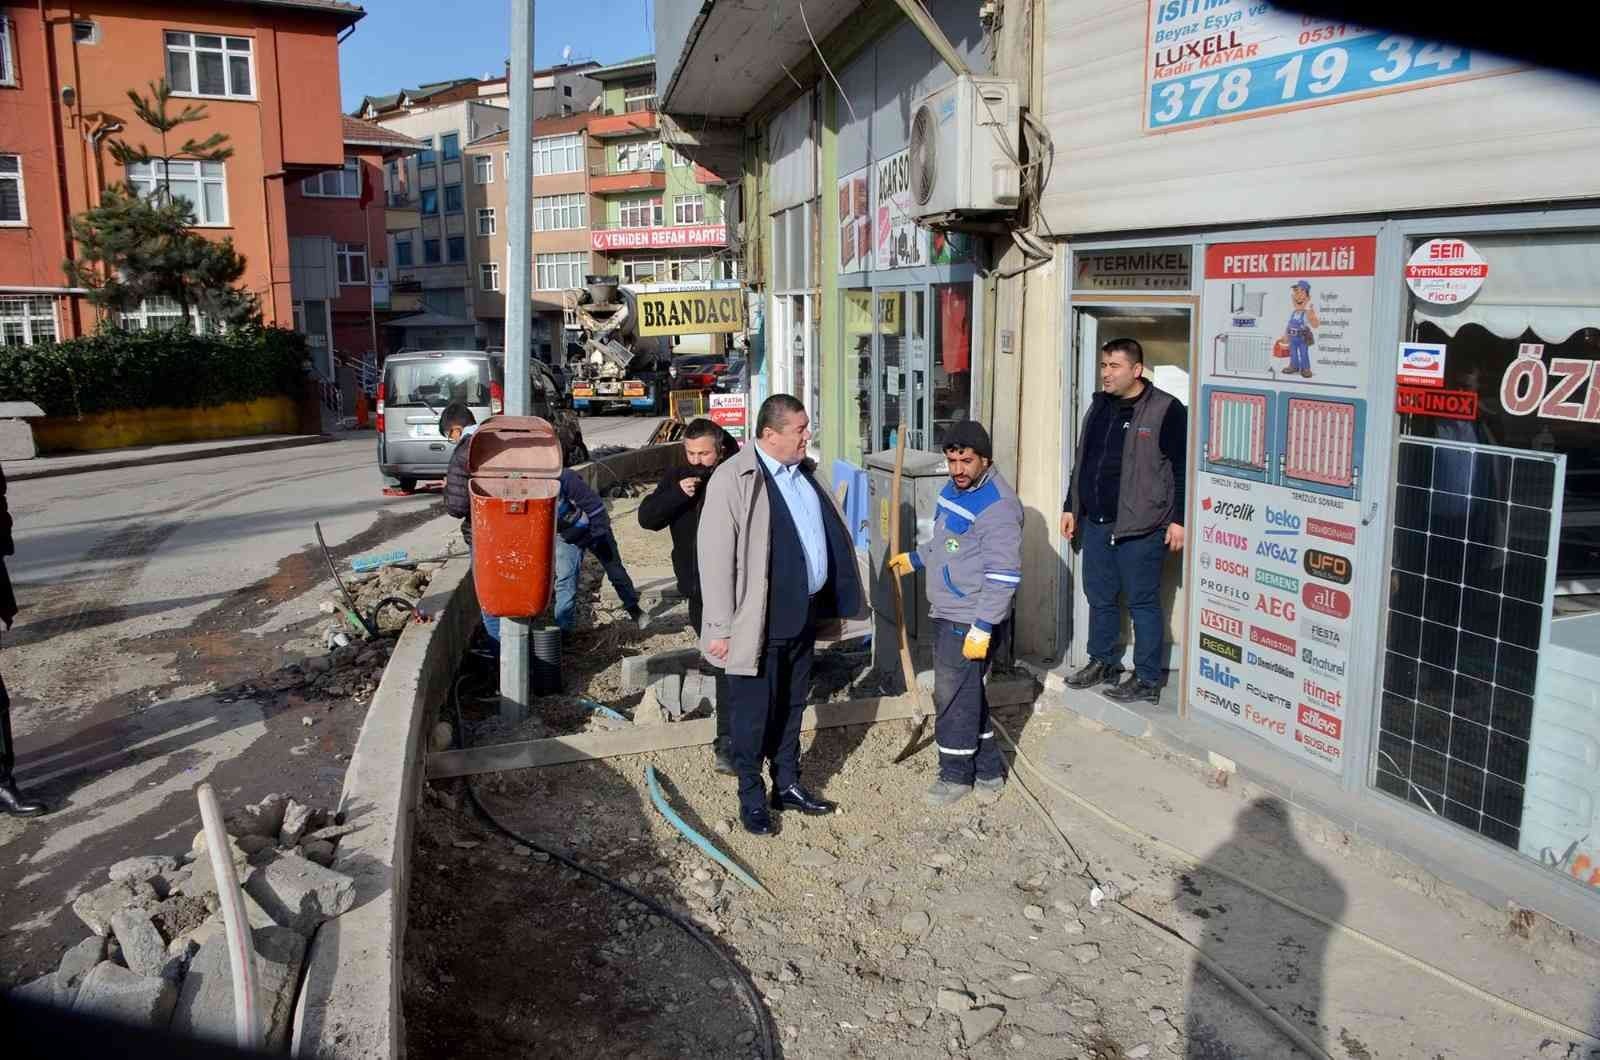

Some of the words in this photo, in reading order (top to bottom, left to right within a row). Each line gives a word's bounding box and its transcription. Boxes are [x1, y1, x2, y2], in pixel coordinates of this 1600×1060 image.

[1155, 23, 1199, 43] Beyaz
[1203, 10, 1242, 29] Eşya
[1248, 4, 1266, 17] ve
[1155, 31, 1243, 67] LUXELL
[1153, 60, 1193, 79] Kadir
[1200, 44, 1258, 69] KAYAR
[1154, 68, 1253, 122] 378
[1275, 47, 1349, 100] 19
[1369, 33, 1461, 82] 34
[606, 230, 649, 246] YENİDEN
[651, 229, 686, 244] REFAH
[1223, 254, 1269, 273] PETEK
[1272, 246, 1357, 272] TEMİZLİĞİ
[1430, 243, 1465, 258] SEM
[643, 297, 737, 327] BRANDACI
[1214, 500, 1256, 521] arçelik
[1265, 506, 1300, 530] beko
[1215, 528, 1248, 551] ALTUS
[1256, 541, 1298, 565] AYGAZ
[1310, 553, 1346, 575] UFO
[1215, 558, 1249, 578] BOSCH
[1255, 592, 1296, 622] AEG
[1201, 609, 1242, 637] VESTEL
[1202, 639, 1239, 659] REGAL
